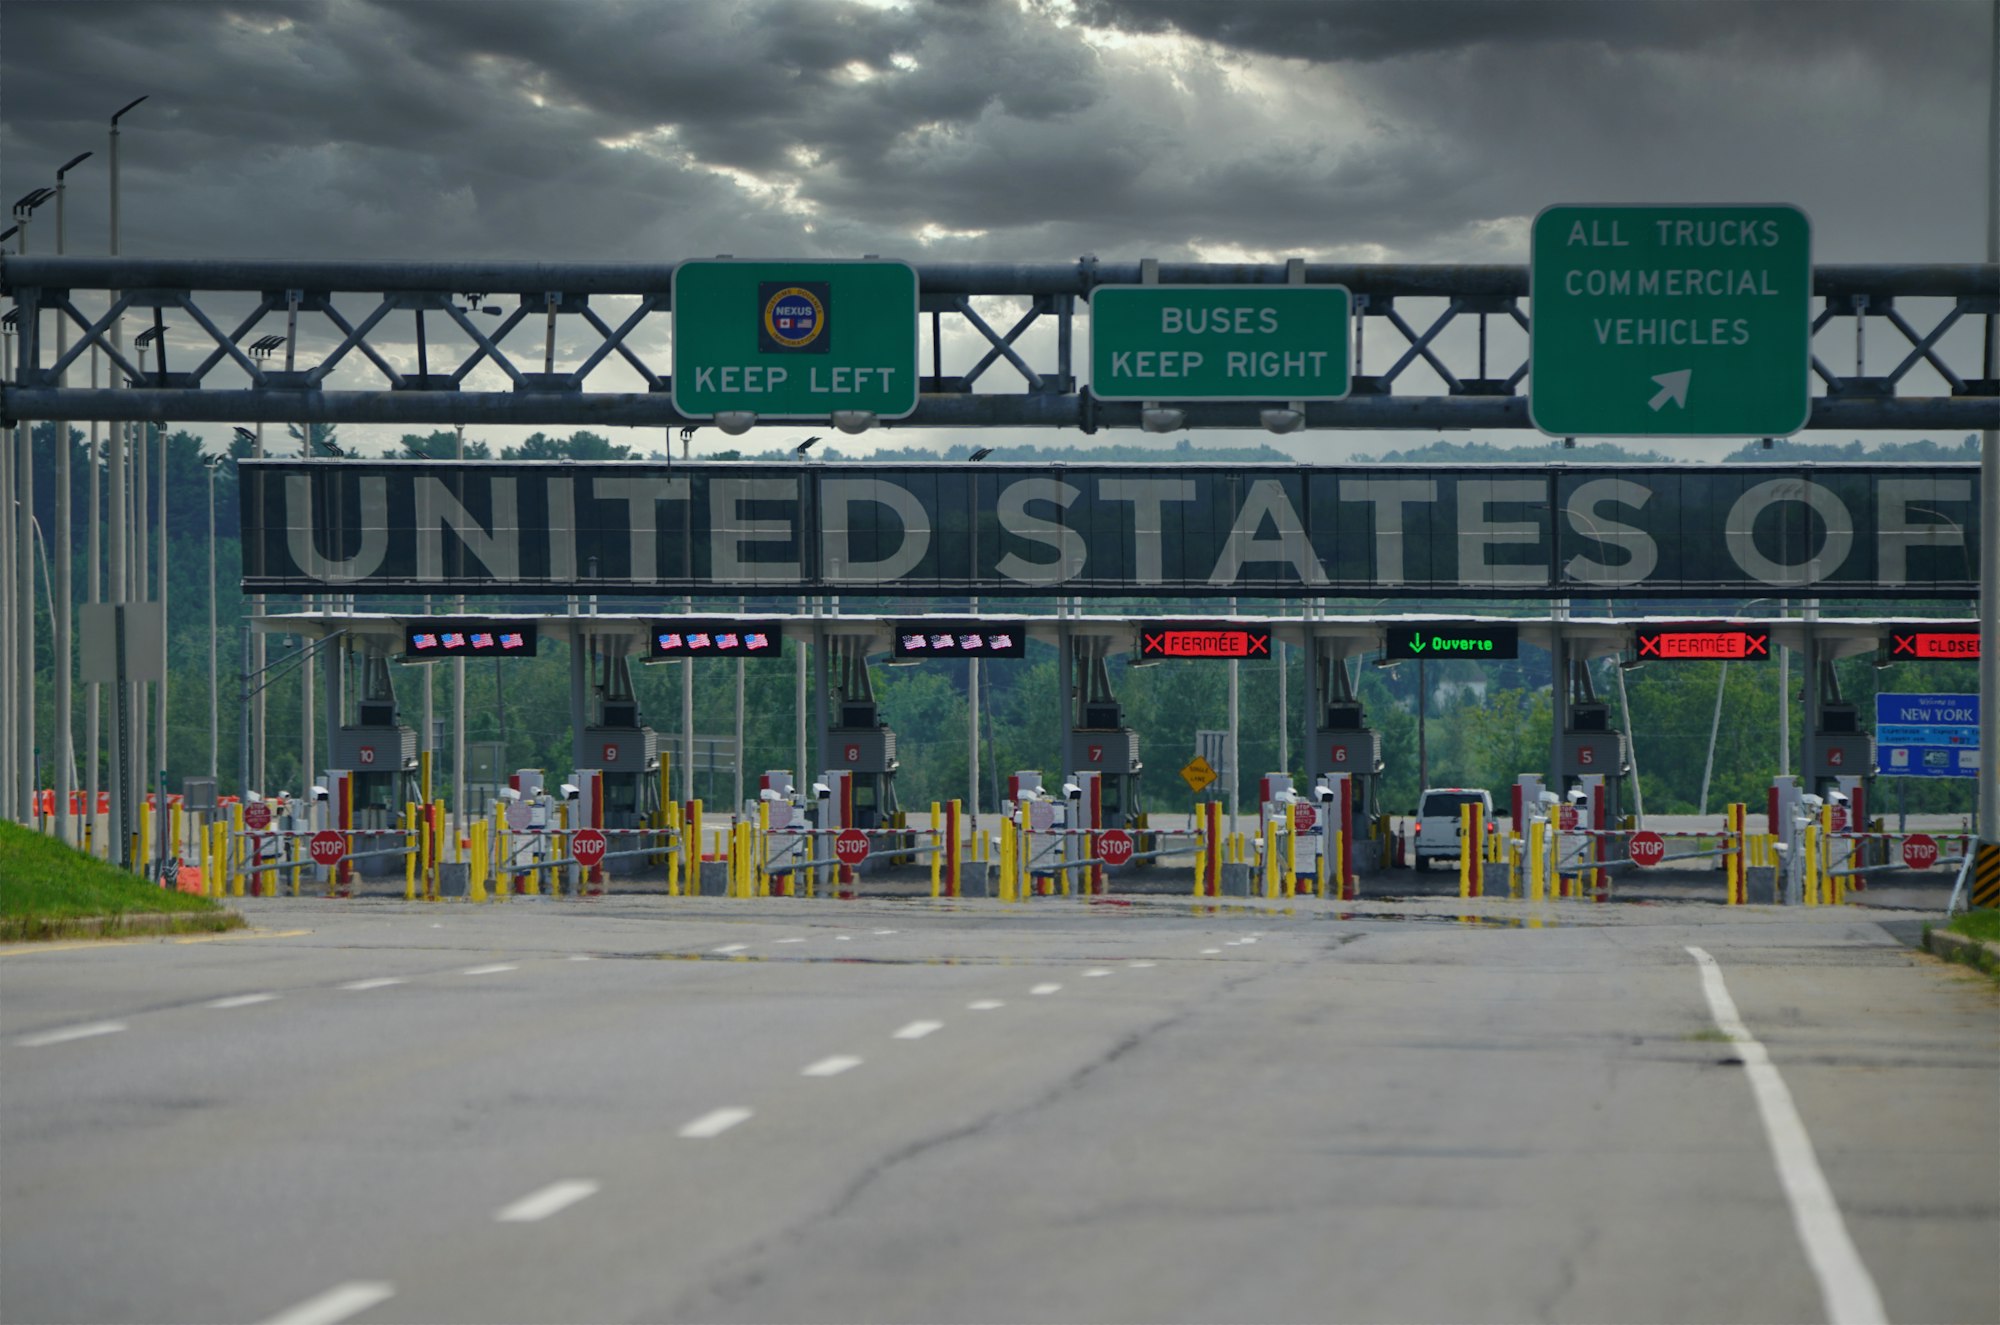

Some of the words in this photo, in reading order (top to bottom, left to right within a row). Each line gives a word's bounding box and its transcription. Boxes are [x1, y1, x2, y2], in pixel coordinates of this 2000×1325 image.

[1567, 219, 1629, 247] ALL
[1656, 219, 1780, 247] TRUCKS
[1565, 269, 1779, 296] COMMERCIAL
[776, 306, 813, 316] NEXUS
[1161, 307, 1279, 334] BUSES
[1593, 318, 1749, 345] VEHICLES
[1111, 351, 1204, 378] KEEP
[1227, 351, 1328, 378] RIGHT
[695, 366, 788, 393] KEEP
[810, 367, 896, 393] LEFT
[284, 475, 931, 585] UNITED
[994, 477, 1659, 587] STATES
[1724, 478, 1973, 587] OF
[1170, 632, 1239, 652] FERMÉE
[1431, 636, 1494, 651] Ouverte
[1667, 634, 1738, 653] FERMÉE
[1928, 639, 1981, 653] CLOSE
[1900, 708, 1931, 721] NEW
[1935, 708, 1974, 722] YORK
[360, 749, 374, 763] 10
[606, 748, 617, 761] 9
[847, 748, 858, 761] 8
[1092, 749, 1102, 761] 7
[1335, 749, 1347, 762] 6
[1582, 751, 1593, 764] 5
[1830, 751, 1842, 765] 4
[312, 841, 343, 855] STOP
[574, 839, 604, 854] STOP
[837, 839, 868, 854] STOP
[1100, 840, 1131, 855] STOP
[1631, 841, 1663, 856] STOP
[1904, 844, 1936, 859] STOP
